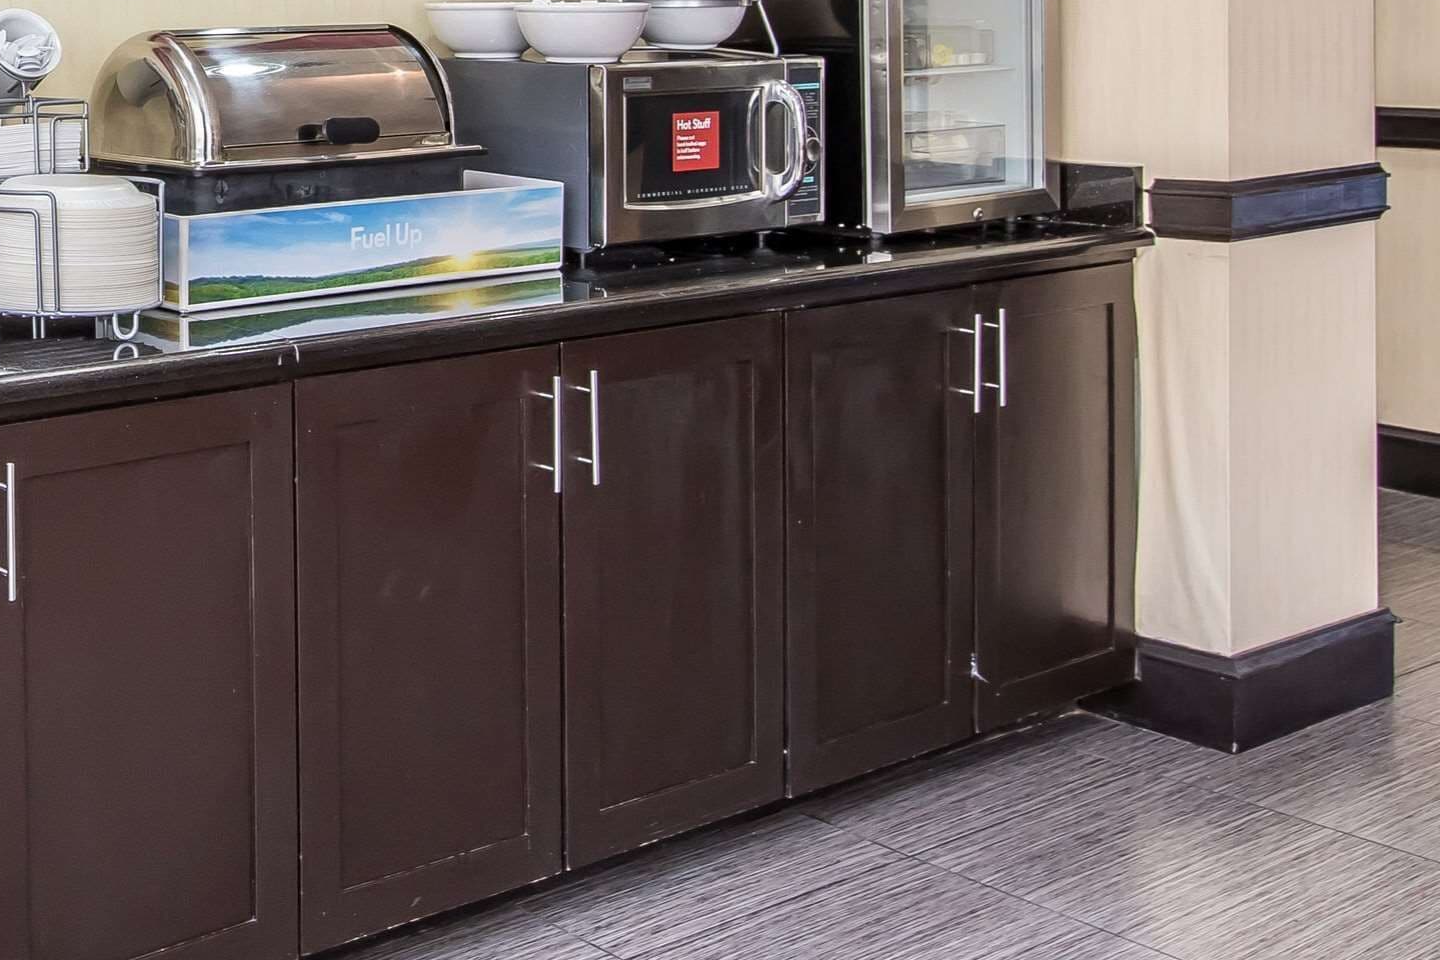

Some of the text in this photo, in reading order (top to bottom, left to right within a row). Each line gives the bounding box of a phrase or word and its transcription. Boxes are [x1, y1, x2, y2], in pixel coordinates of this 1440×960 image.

[676, 117, 712, 131] Hot Stuff
[350, 222, 423, 251] Fuel Up
